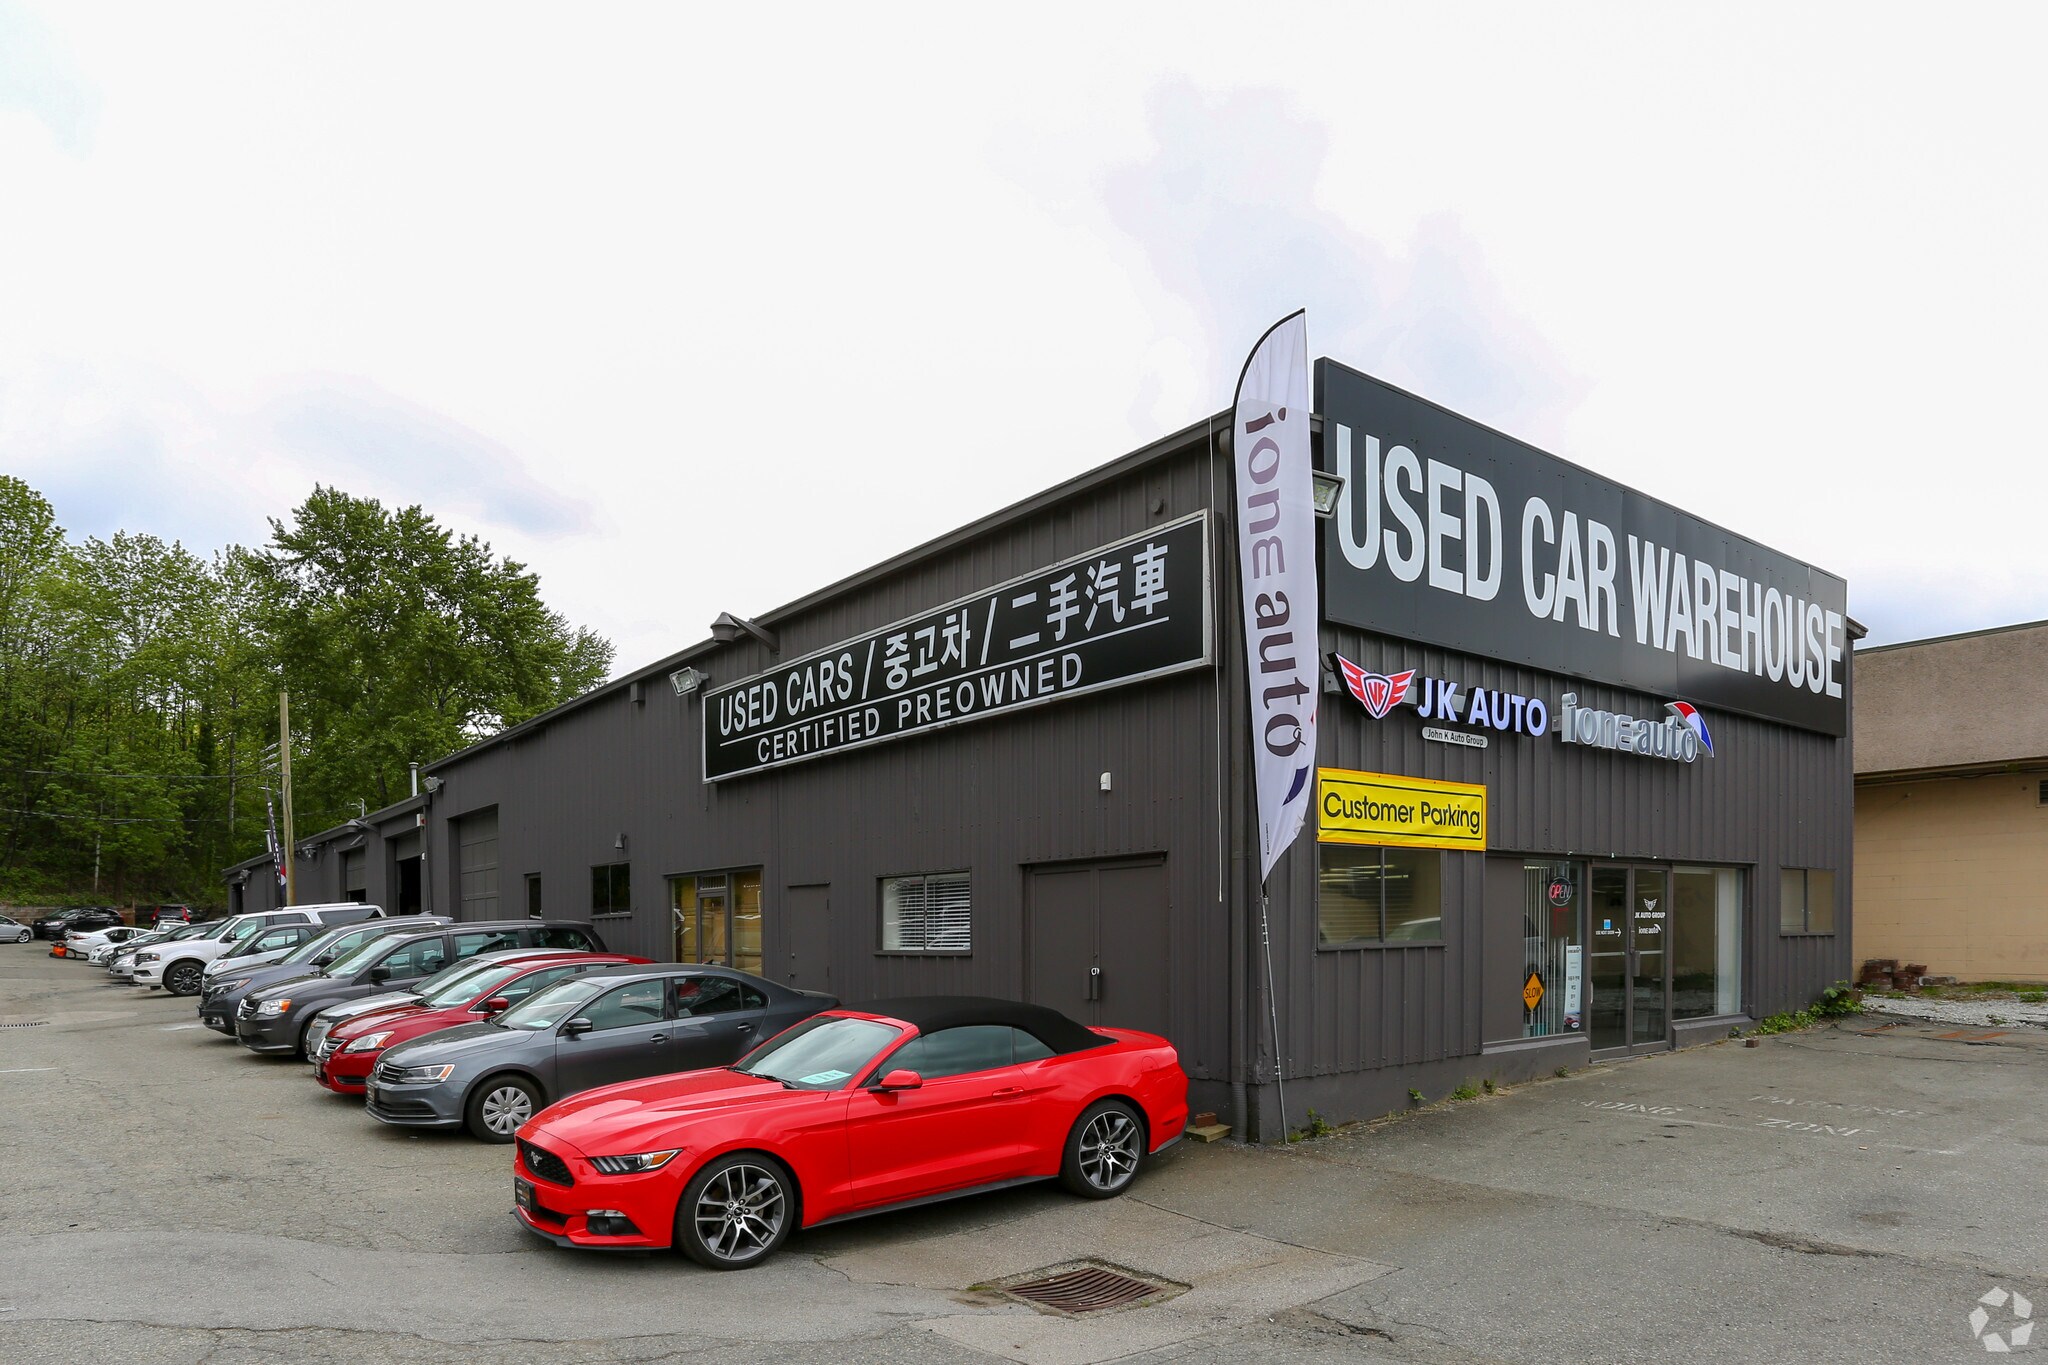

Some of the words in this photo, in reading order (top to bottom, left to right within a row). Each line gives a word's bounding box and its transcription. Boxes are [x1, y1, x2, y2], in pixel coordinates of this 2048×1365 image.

[1336, 423, 1503, 602] USED
[1521, 496, 1620, 638] CAR
[1627, 533, 1843, 699] WAREHOUSE
[720, 681, 778, 736] USED
[786, 652, 853, 716] CARS
[883, 614, 971, 690] 중고차
[1009, 543, 1169, 650] 二手汽車
[757, 707, 880, 763] CERTIFIED
[898, 652, 1082, 729] PREOWNED
[1417, 677, 1458, 722] JK
[1468, 687, 1547, 737] AUTO
[1427, 728, 1443, 741] John
[1450, 733, 1464, 743] Auto
[1466, 735, 1484, 747] Group
[1323, 791, 1415, 824] Customer
[1421, 801, 1480, 835] Parking
[1550, 884, 1570, 899] OPEN
[1640, 911, 1651, 919] AUTO
[1651, 911, 1666, 919] GROUP
[1525, 986, 1541, 999] SLOW
